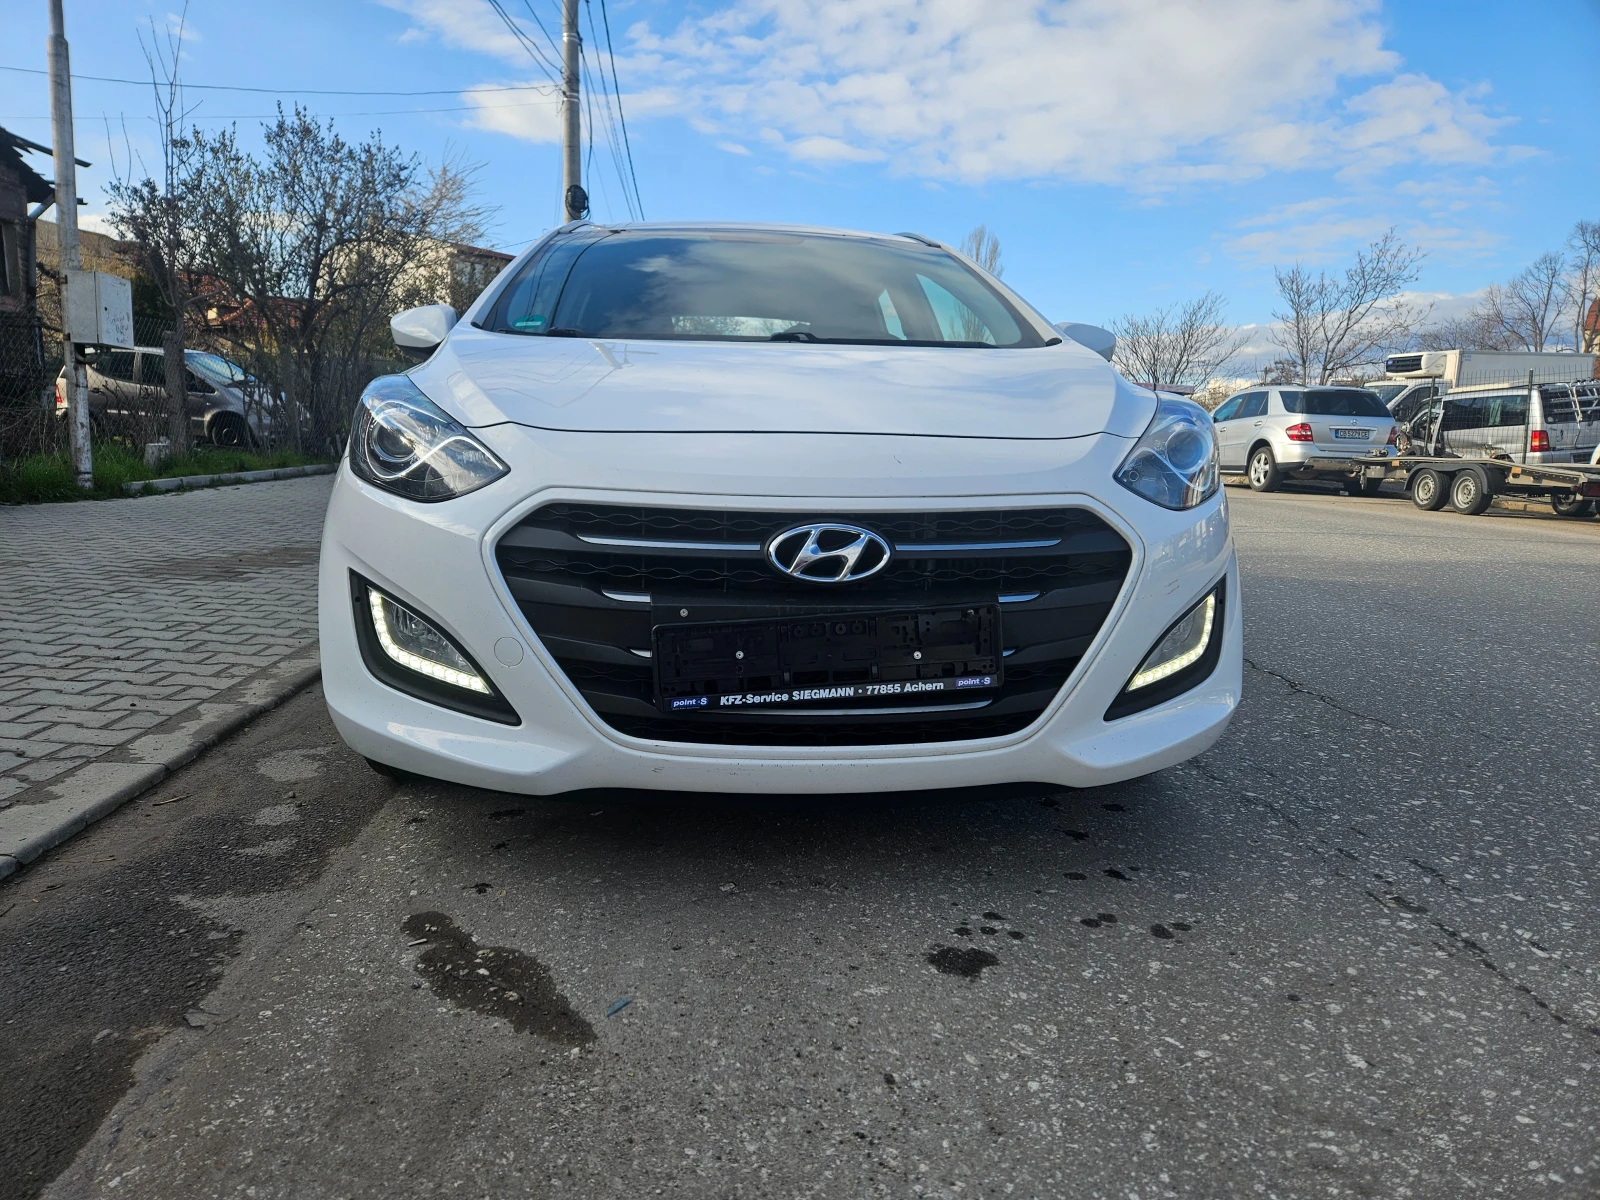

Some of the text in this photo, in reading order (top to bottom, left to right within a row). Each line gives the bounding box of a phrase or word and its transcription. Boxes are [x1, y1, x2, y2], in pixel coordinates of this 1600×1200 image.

[958, 678, 980, 687] point
[720, 681, 944, 706] KFZ-Service SIEGMANN 77855 Achern
[673, 698, 696, 708] point
